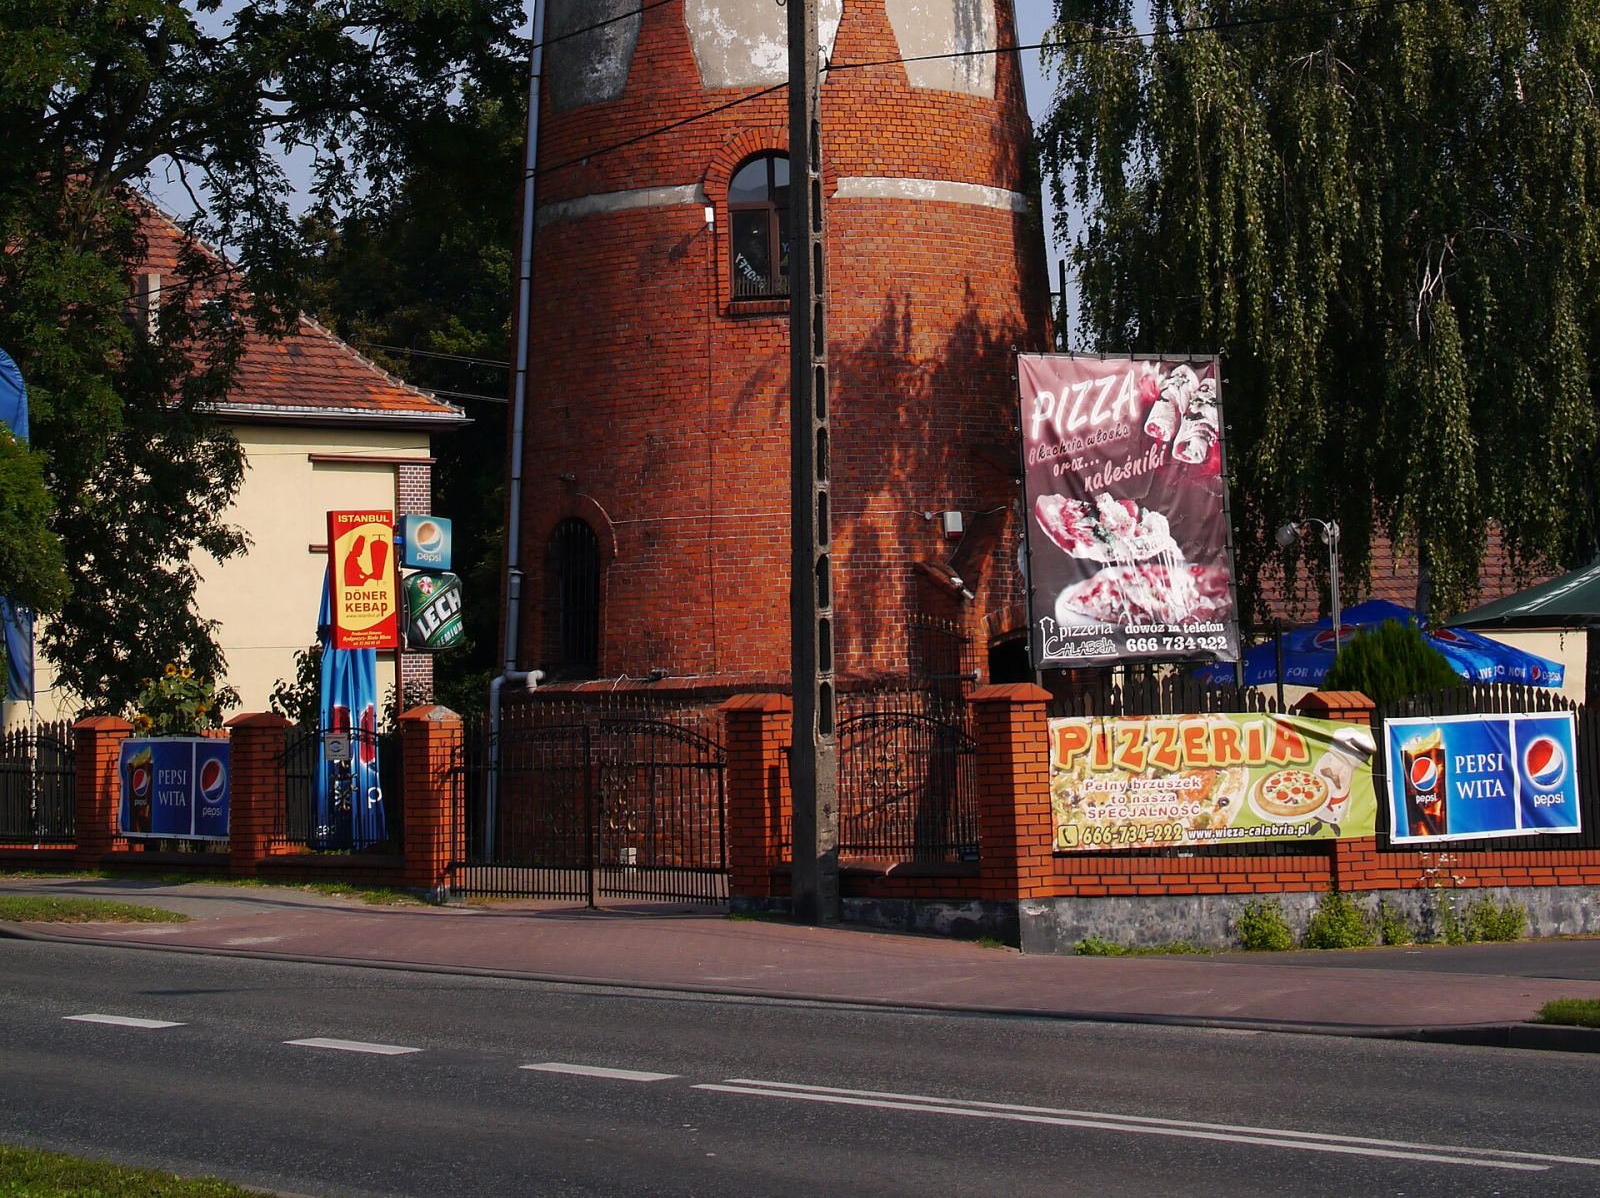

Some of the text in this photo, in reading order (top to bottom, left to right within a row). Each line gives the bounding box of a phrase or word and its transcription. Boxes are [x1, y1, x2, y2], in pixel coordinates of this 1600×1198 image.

[1031, 369, 1137, 440] PIZZA
[1038, 438, 1083, 460] kuchnia
[1087, 423, 1130, 446] włoska
[1084, 442, 1167, 492] naleśniki
[338, 514, 390, 523] ISTANBUL
[416, 552, 442, 562] pepsi
[345, 588, 387, 601] DÖNER
[416, 587, 462, 641] LECH
[1059, 620, 1114, 641] pizzeria
[1125, 621, 1165, 634] dowóz
[1183, 621, 1225, 634] telefon
[1046, 636, 1116, 656] CALABRIA
[1126, 636, 1228, 652] 666 734 222
[1257, 668, 1278, 678] LIV
[1286, 667, 1308, 678] FOR
[1053, 720, 1310, 772] PIZZERIA
[1455, 753, 1504, 774] PEPSI
[158, 769, 186, 785] PEPSI
[1133, 778, 1201, 790] brzuszek
[1456, 779, 1507, 800] WITA
[158, 791, 186, 807] WITA
[1111, 793, 1176, 804] to nasza
[1415, 793, 1437, 805] pepsi
[1533, 791, 1565, 808] pepsi
[202, 807, 222, 818] pepsi
[1087, 802, 1200, 819] SPECJALNOŚĆ
[1082, 822, 1311, 845] 666-734-222 www.wieza-calabria.pl
